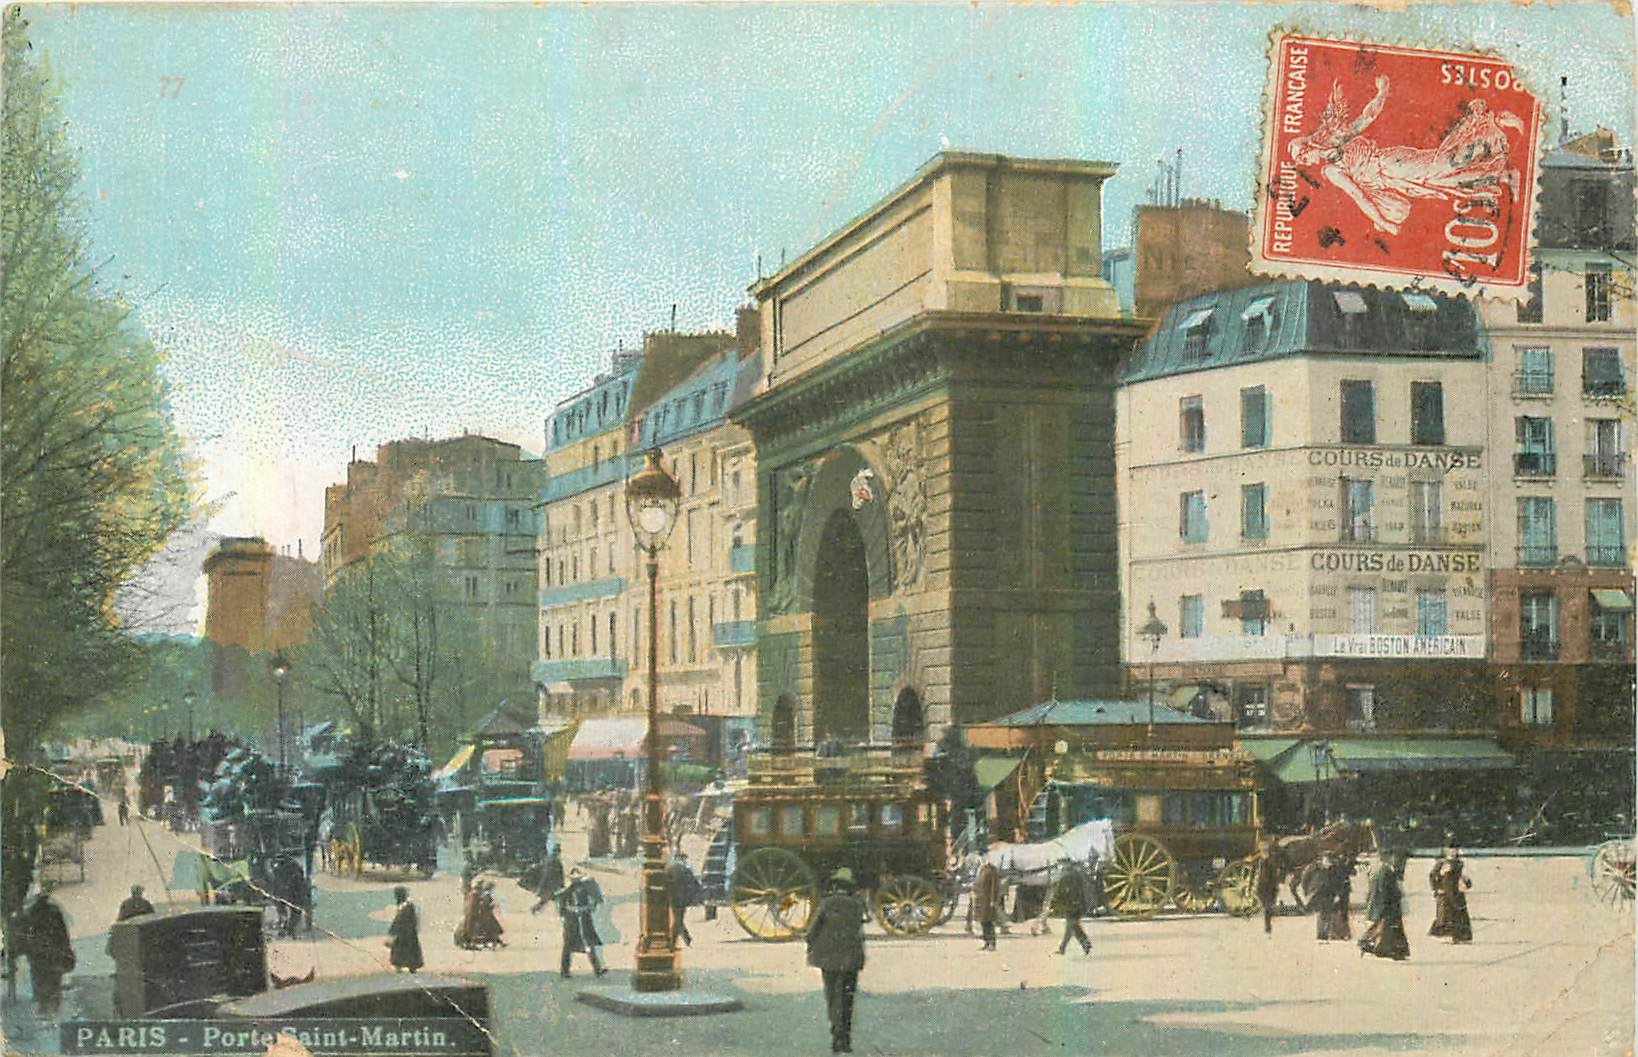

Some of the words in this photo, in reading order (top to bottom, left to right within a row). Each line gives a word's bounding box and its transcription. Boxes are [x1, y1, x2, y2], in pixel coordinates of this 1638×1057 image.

[1441, 62, 1525, 92] POSTES
[1308, 451, 1383, 467] COURS
[1386, 452, 1401, 468] de
[1405, 451, 1482, 469] DANSE
[1311, 552, 1383, 571] COURS
[1387, 553, 1404, 571] de
[1408, 553, 1480, 572] DANSE
[1369, 636, 1409, 655] BOSTON
